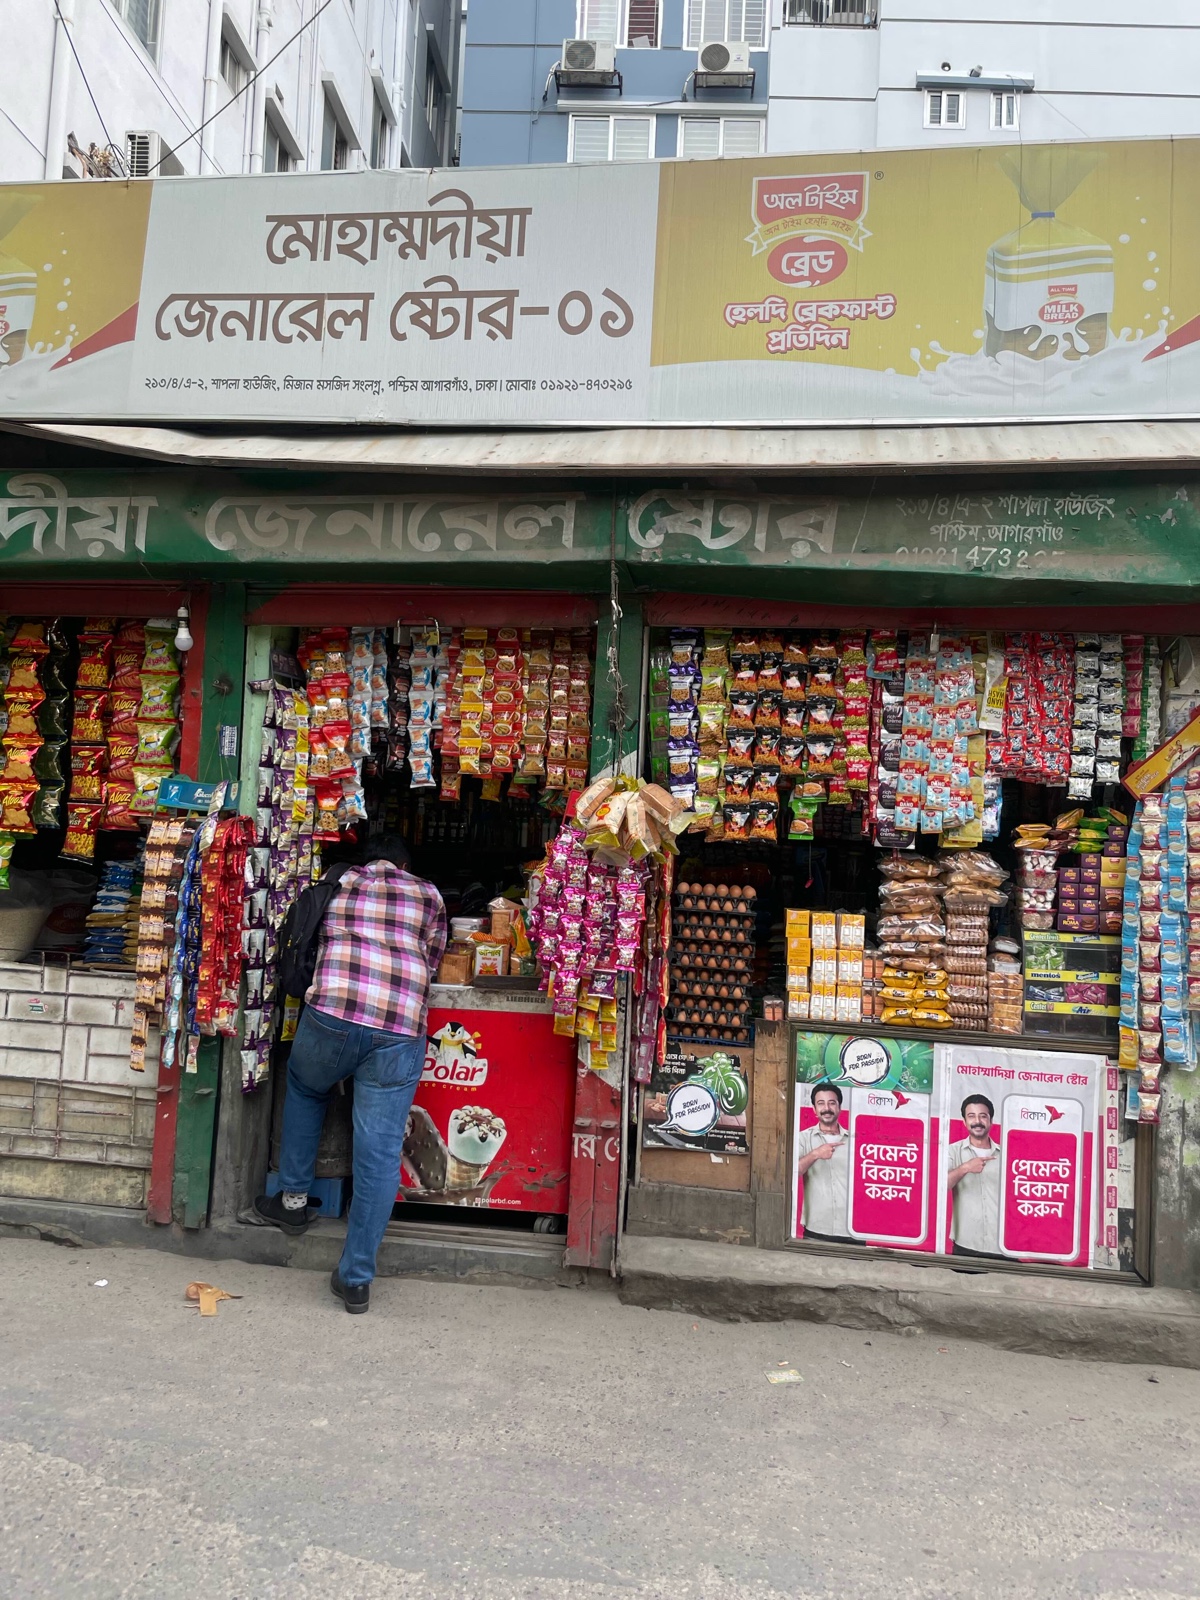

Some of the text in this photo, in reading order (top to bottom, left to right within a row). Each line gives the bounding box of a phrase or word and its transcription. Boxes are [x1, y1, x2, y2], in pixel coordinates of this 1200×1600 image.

[763, 183, 859, 210] অল টাইম
[266, 189, 533, 265] মোহাম্মদীয়া
[782, 218, 803, 231] টাইম
[781, 250, 835, 277] ব্রেড
[725, 294, 896, 326] হেলদি ব্রেকফাস্ট
[1044, 303, 1079, 313] MILK
[155, 291, 375, 344] জেনারেল
[1043, 312, 1079, 320] BREAD
[767, 324, 849, 351] প্রতিদিন
[211, 378, 241, 390] শাপলা
[283, 375, 313, 390] মিজান
[316, 376, 350, 391] মসজিদ
[388, 376, 418, 392] পশ্চিম
[540, 378, 633, 392] ০১৯২১-৪৭৩২৯৫
[205, 493, 587, 555] জেনারেল
[988, 689, 1005, 698] WASH
[114, 699, 136, 711] Alooz
[987, 697, 1005, 708] HAND
[110, 745, 133, 758] Alooz
[108, 792, 131, 805] Alooz
[1062, 919, 1080, 927] ROMA
[505, 995, 547, 1004] LIEBHERR
[848, 1056, 885, 1071] FOR PASSION
[856, 1053, 872, 1062] BORN
[422, 1057, 484, 1082] Polar
[1018, 1070, 1064, 1084] জেনারেল
[442, 1084, 477, 1092] cream
[682, 1099, 699, 1109] BORN
[867, 1093, 893, 1106] বিকাশ
[674, 1103, 711, 1119] FOR PASSION
[1020, 1107, 1047, 1121] বিকাশ
[859, 1143, 919, 1163] পেমেন্ট
[860, 1159, 917, 1184] বিকাশ
[1011, 1157, 1072, 1179] পেমেন্ট
[864, 1183, 912, 1203] করুন
[1012, 1175, 1069, 1199] বিকাশ
[481, 1197, 522, 1205] polarbd.com
[1016, 1199, 1065, 1219] করুন
